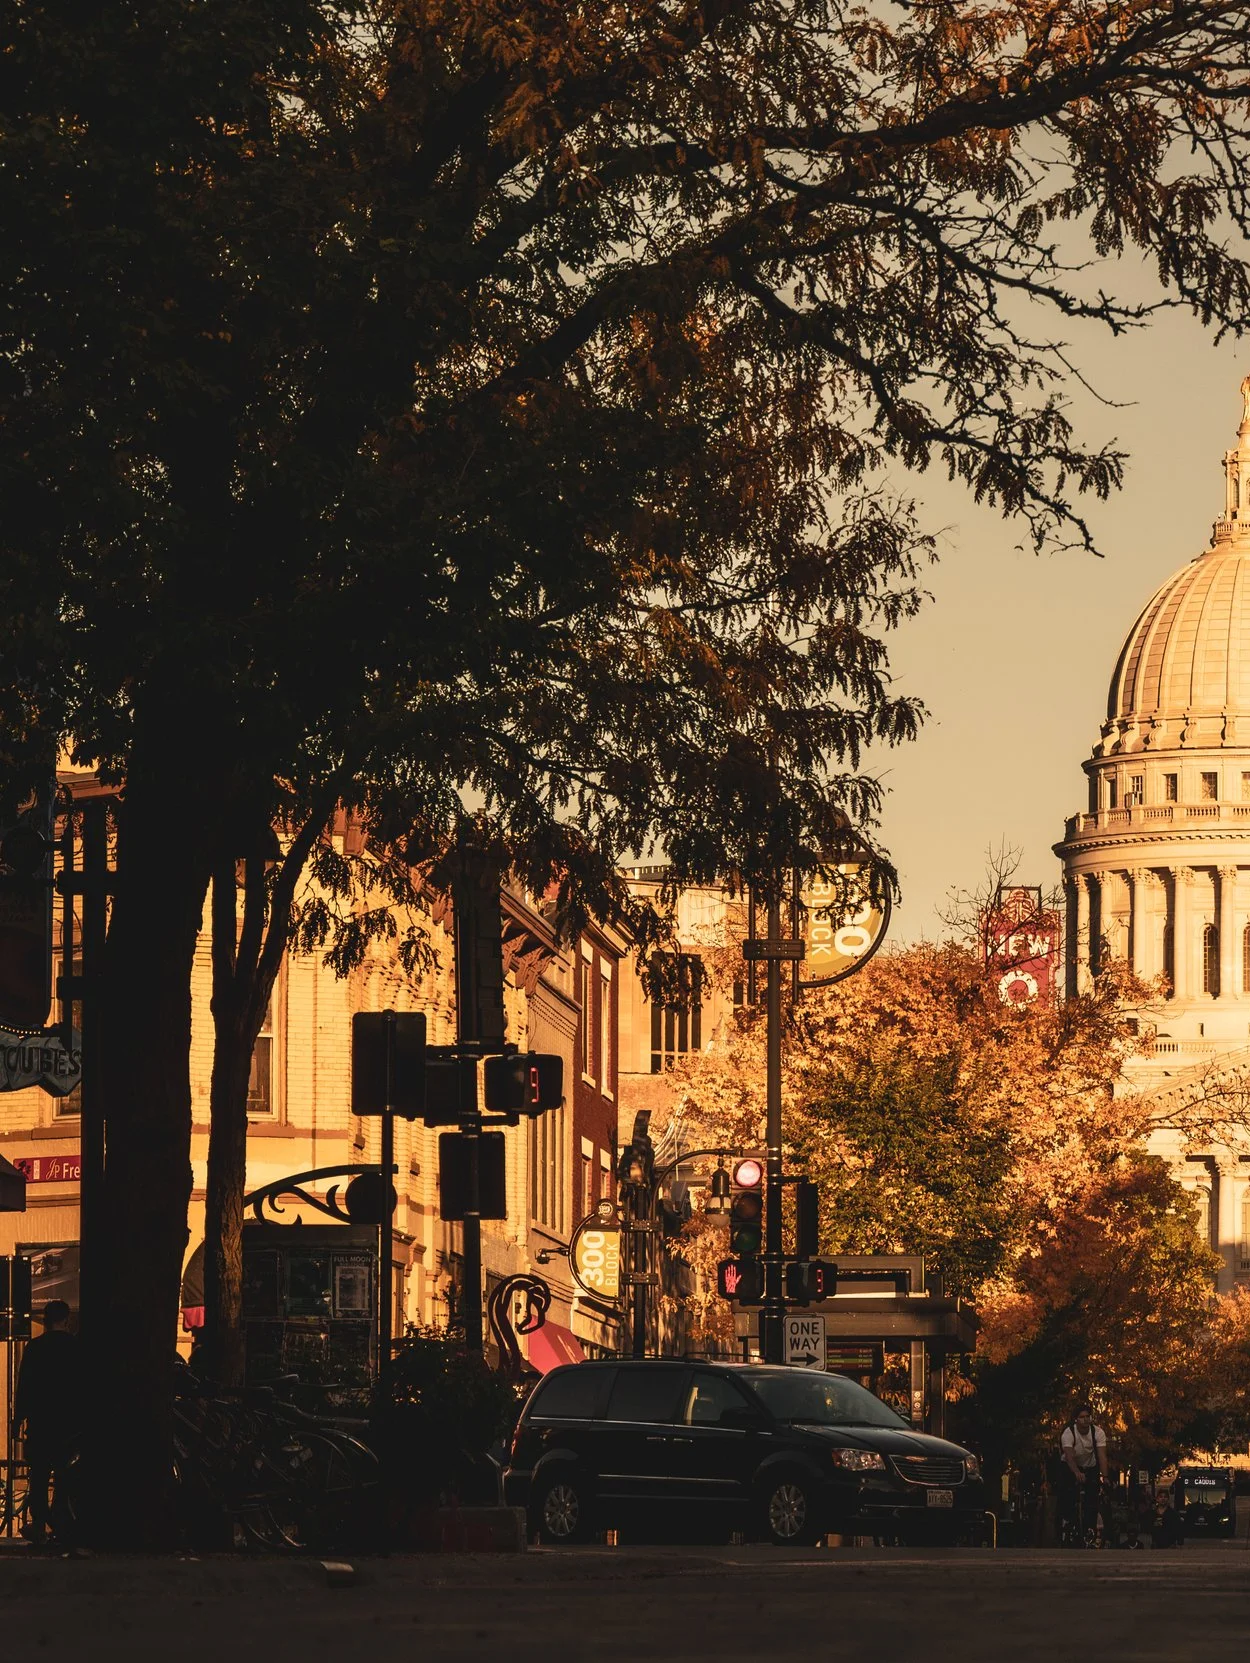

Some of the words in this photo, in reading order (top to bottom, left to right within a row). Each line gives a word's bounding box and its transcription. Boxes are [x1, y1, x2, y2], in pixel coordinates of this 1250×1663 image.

[811, 882, 832, 956] BLOCK
[581, 1231, 605, 1287] 300
[605, 1243, 618, 1287] BLOCK
[789, 1337, 820, 1351] WAY
[790, 1321, 820, 1335] ONE
